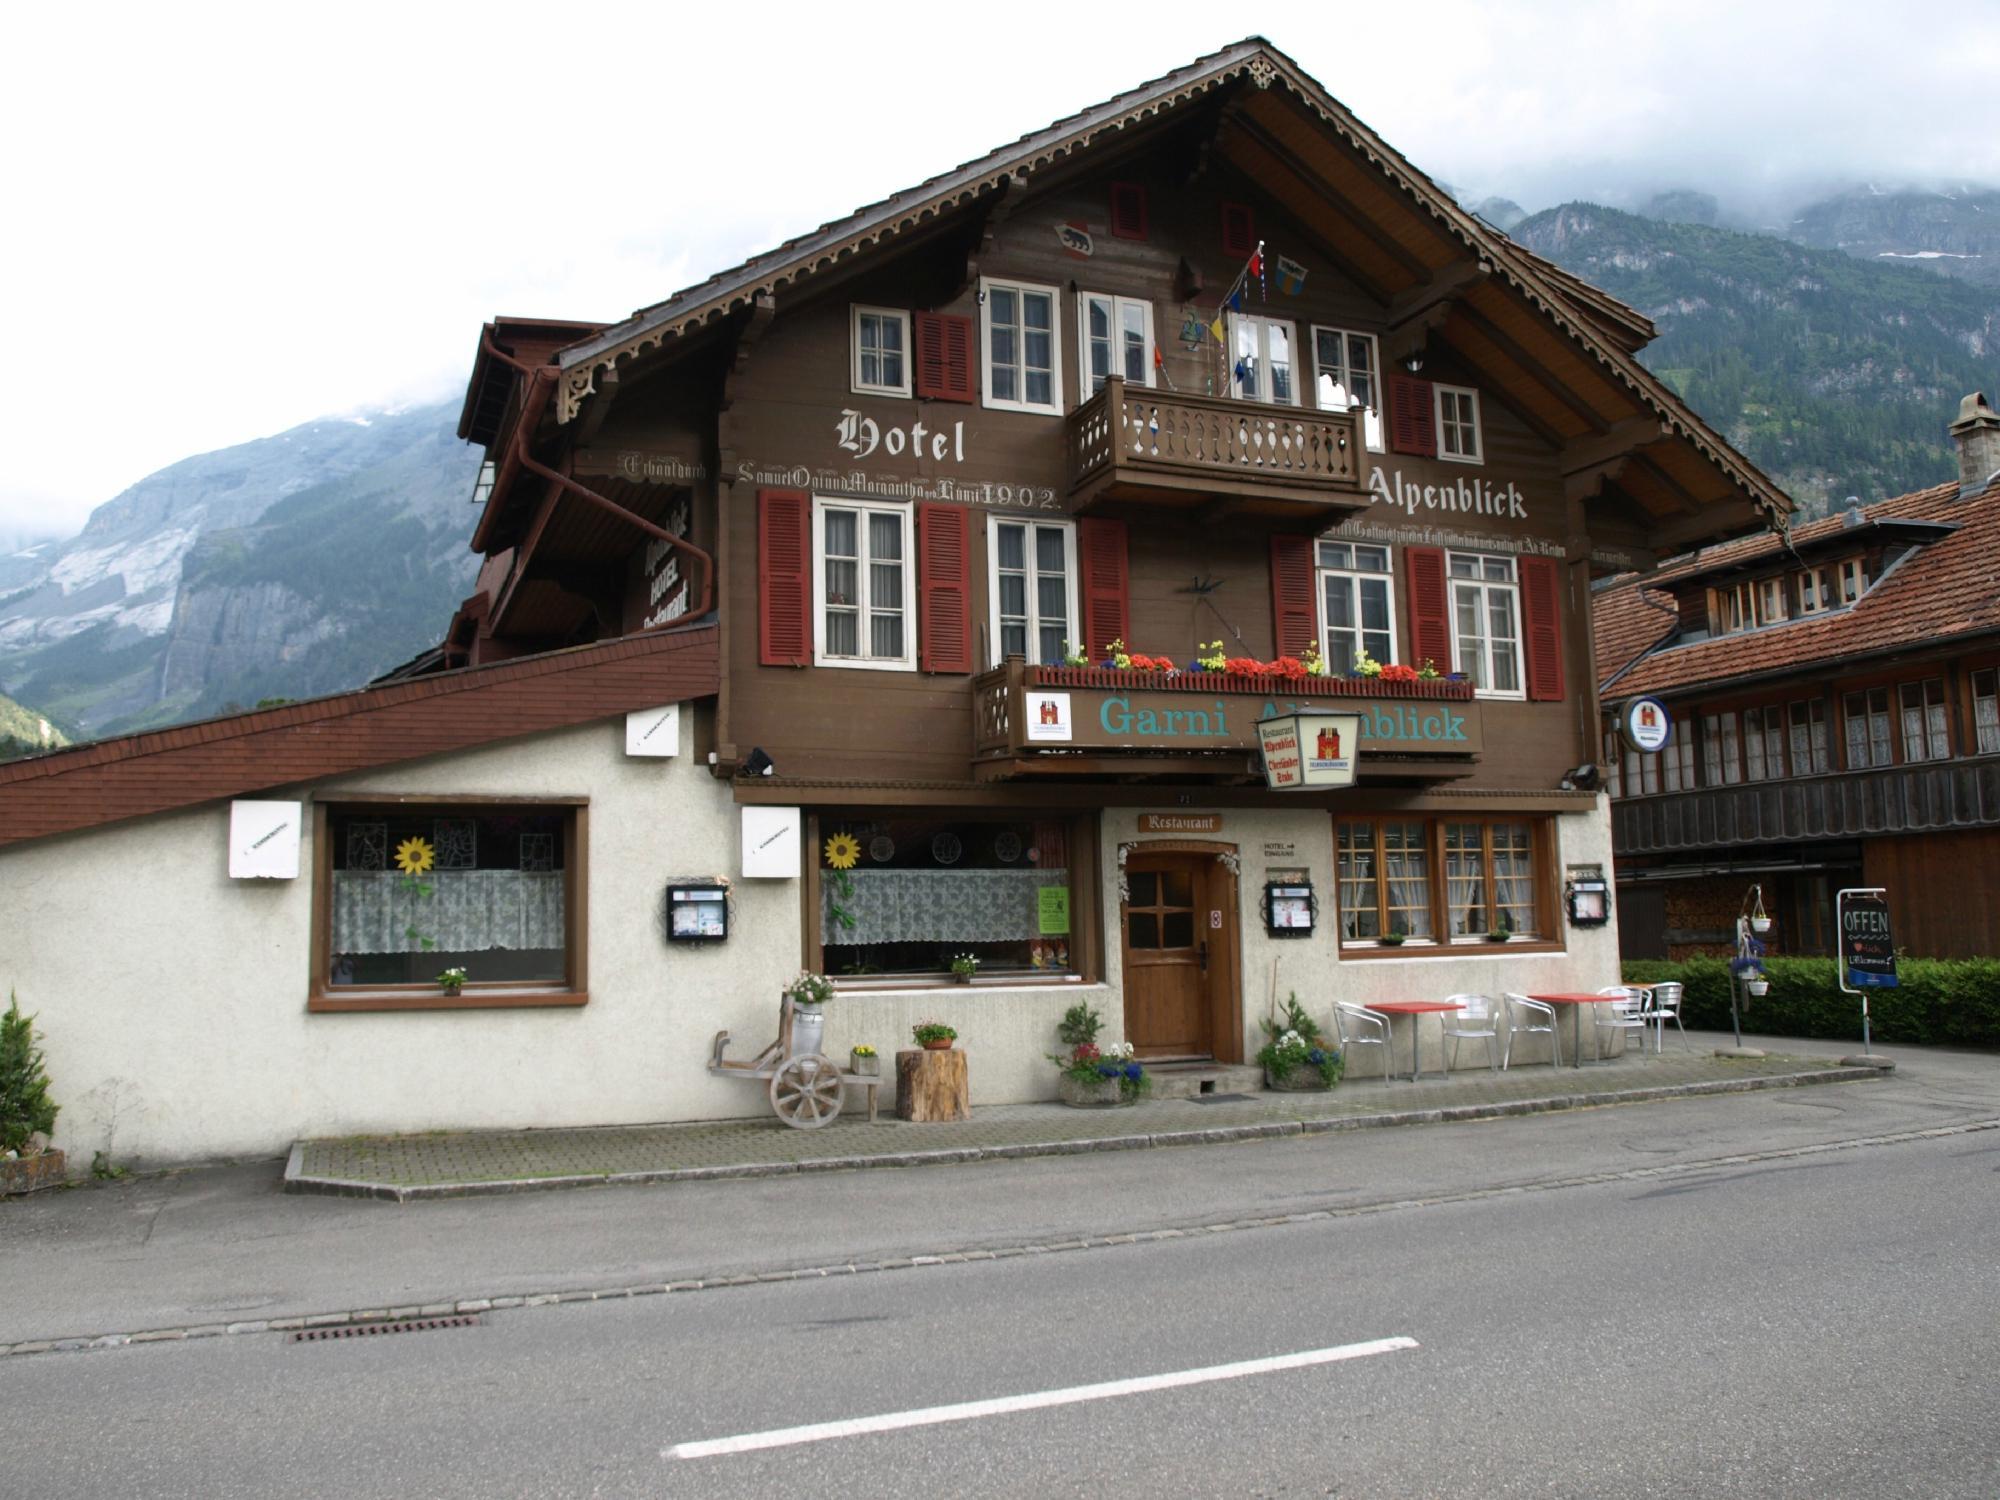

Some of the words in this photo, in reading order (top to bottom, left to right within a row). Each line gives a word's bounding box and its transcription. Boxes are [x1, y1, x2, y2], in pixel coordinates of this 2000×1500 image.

[835, 409, 963, 461] Hotel
[1369, 466, 1528, 518] Alpenblick
[651, 557, 678, 607] HOTEL
[1100, 697, 1229, 737] Garni
[1148, 815, 1214, 830] Restaurant
[1844, 911, 1888, 932] OFFEN
